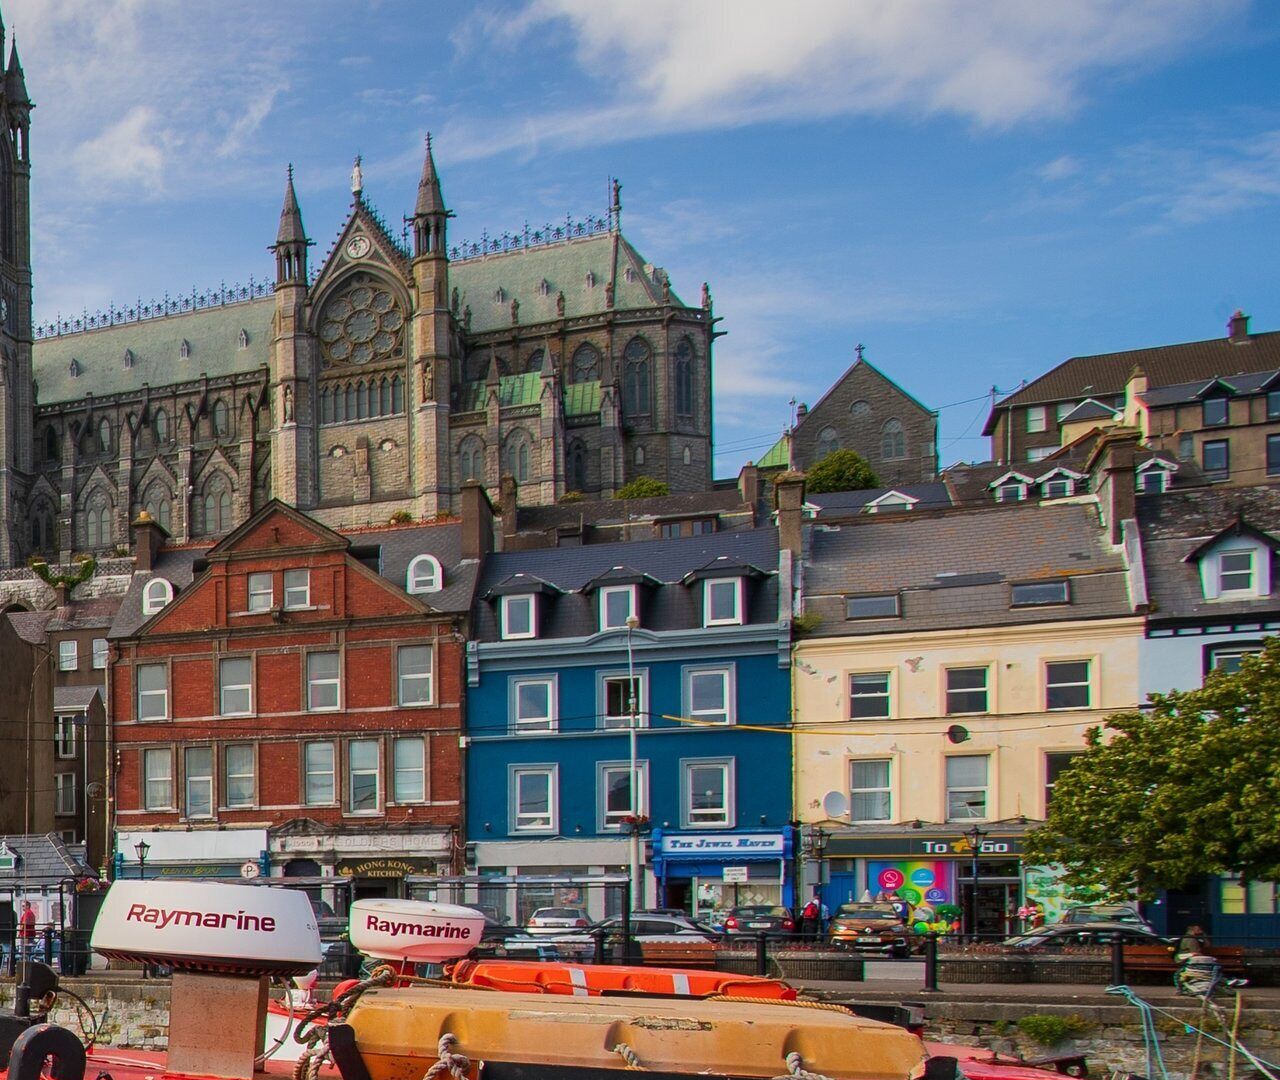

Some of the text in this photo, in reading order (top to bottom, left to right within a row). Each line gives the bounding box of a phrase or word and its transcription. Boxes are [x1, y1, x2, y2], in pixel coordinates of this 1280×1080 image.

[695, 839, 733, 848] JEWEL
[736, 838, 776, 848] HAVEN
[357, 859, 416, 874] HONG KONG
[126, 903, 276, 932] Raymarine
[366, 914, 471, 939] Raymarine
